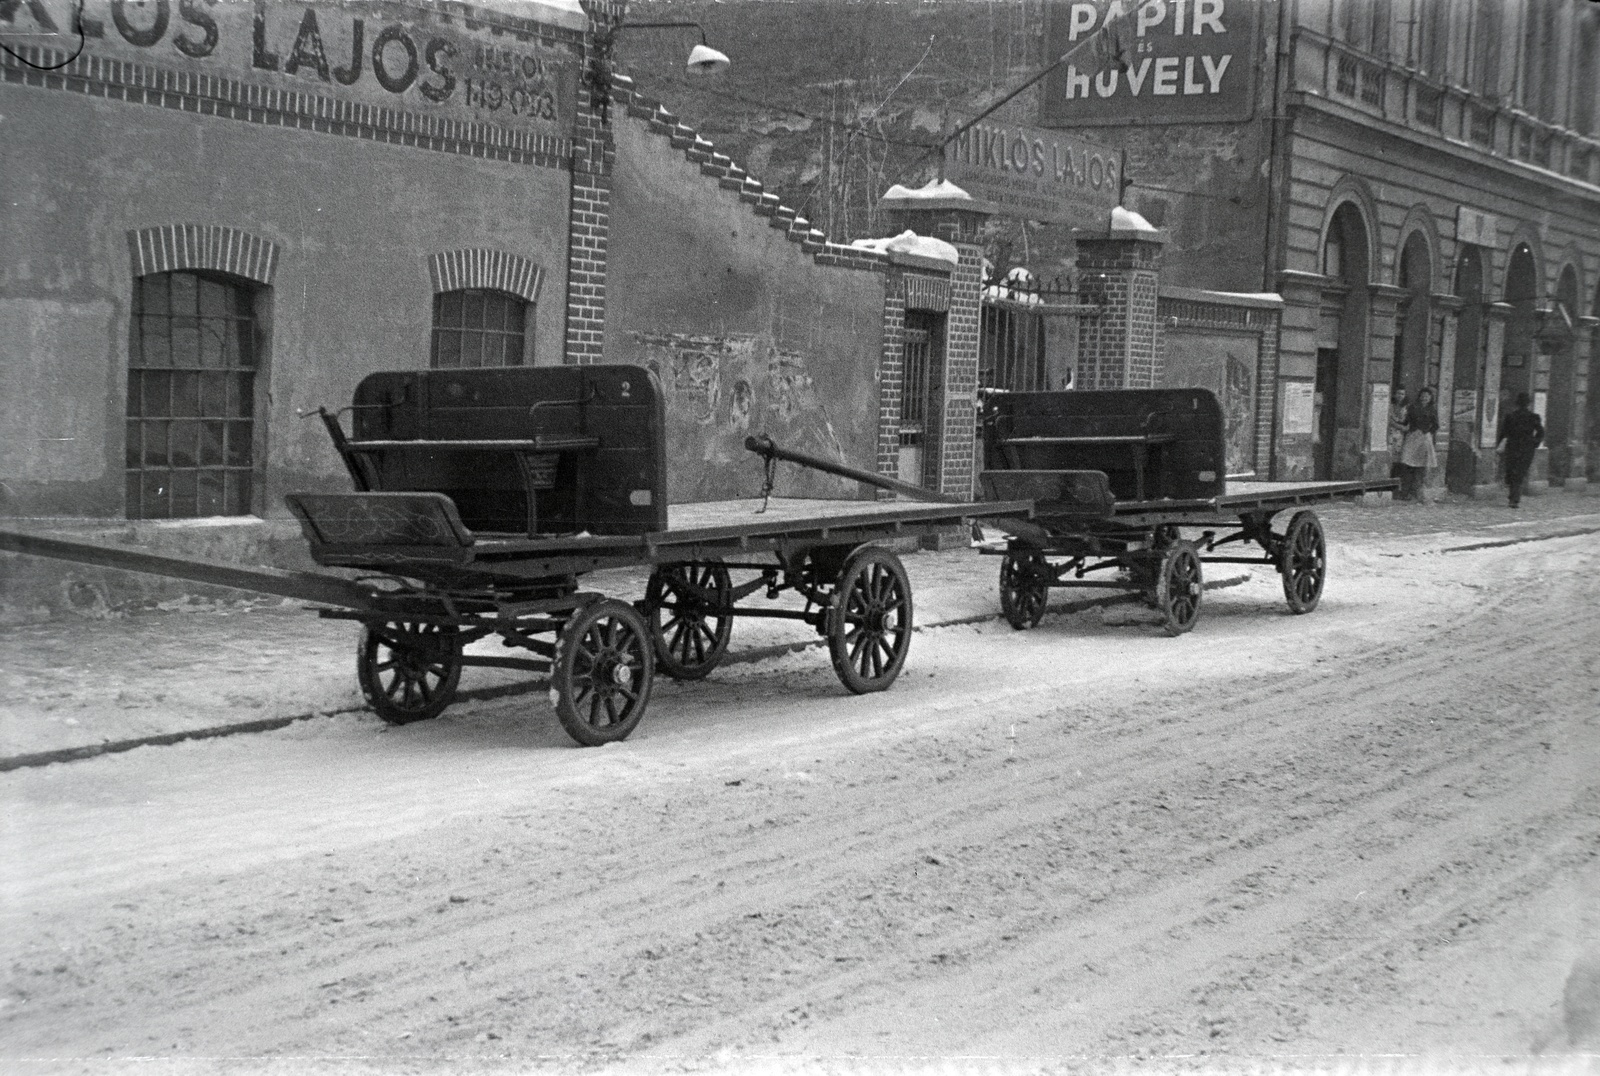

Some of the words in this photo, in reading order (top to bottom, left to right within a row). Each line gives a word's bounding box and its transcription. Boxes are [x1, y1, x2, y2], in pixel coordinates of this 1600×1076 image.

[254, 5, 456, 102] LAJOS
[1052, 142, 1116, 193] LAJOS
[621, 381, 631, 397] 2
